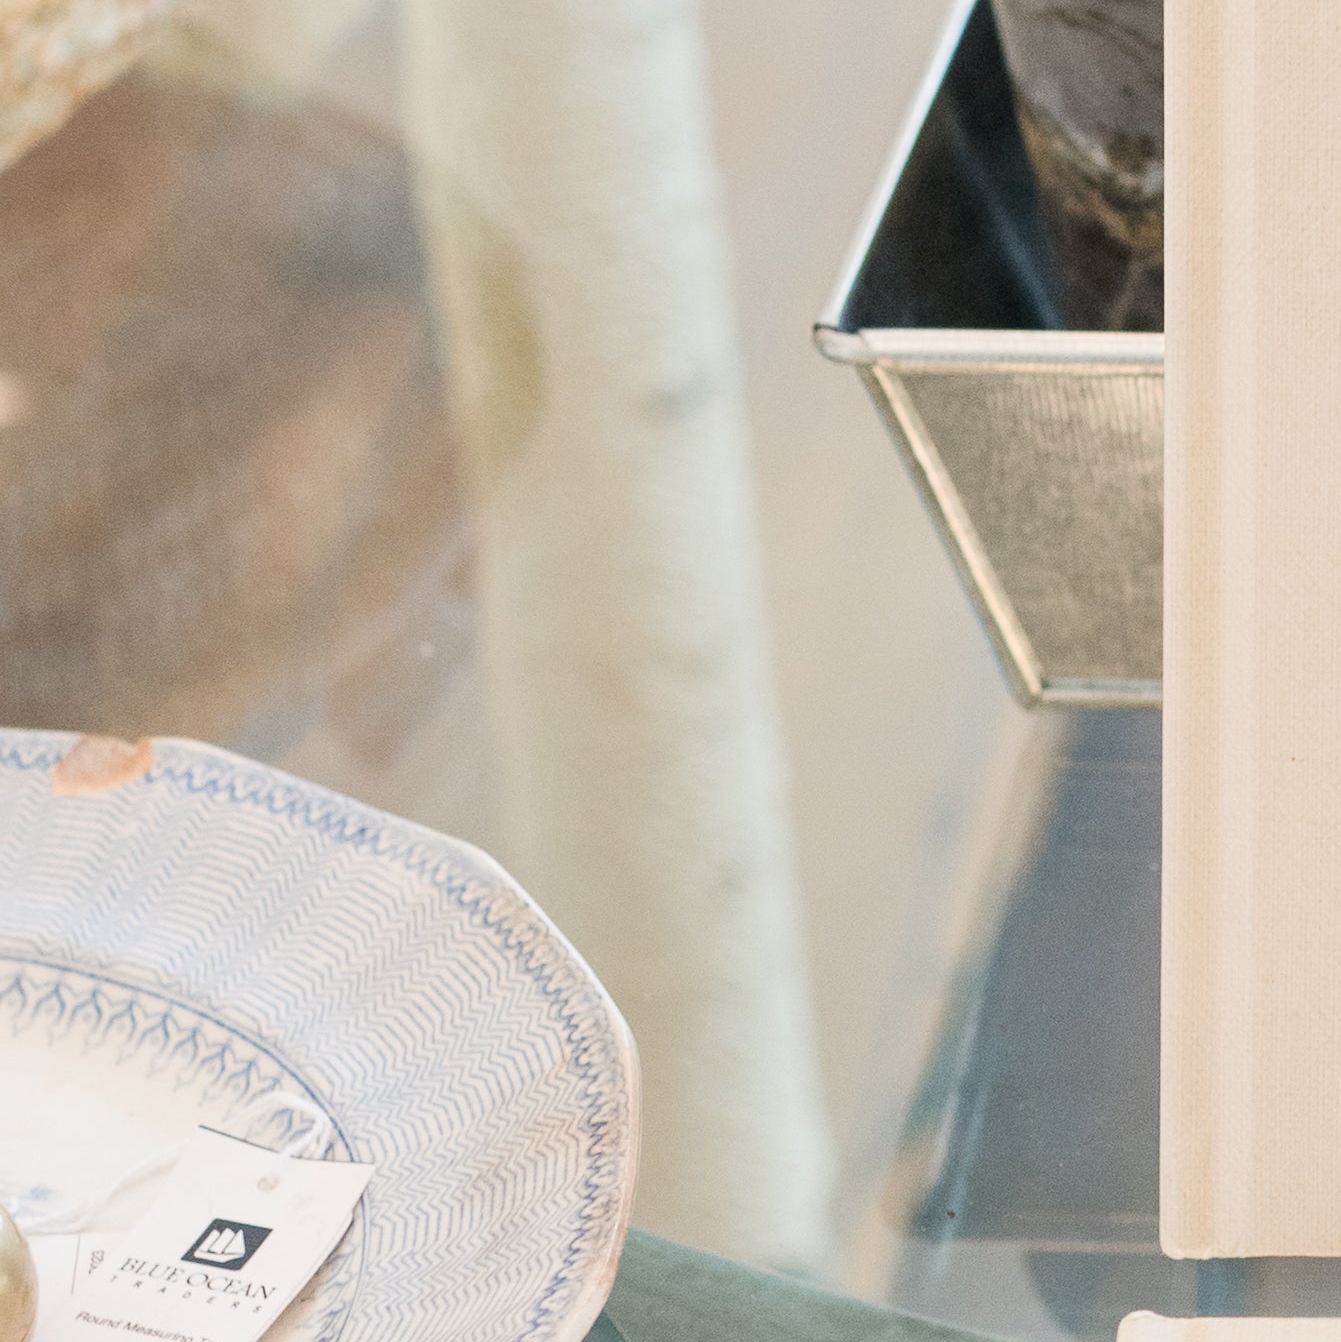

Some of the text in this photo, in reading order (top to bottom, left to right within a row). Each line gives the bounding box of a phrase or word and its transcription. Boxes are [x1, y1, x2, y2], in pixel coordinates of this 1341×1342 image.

[110, 1275, 264, 1313] TRADERS
[118, 1257, 184, 1283] BLUE
[186, 1271, 276, 1300] OCEAN
[75, 1310, 121, 1330] Round
